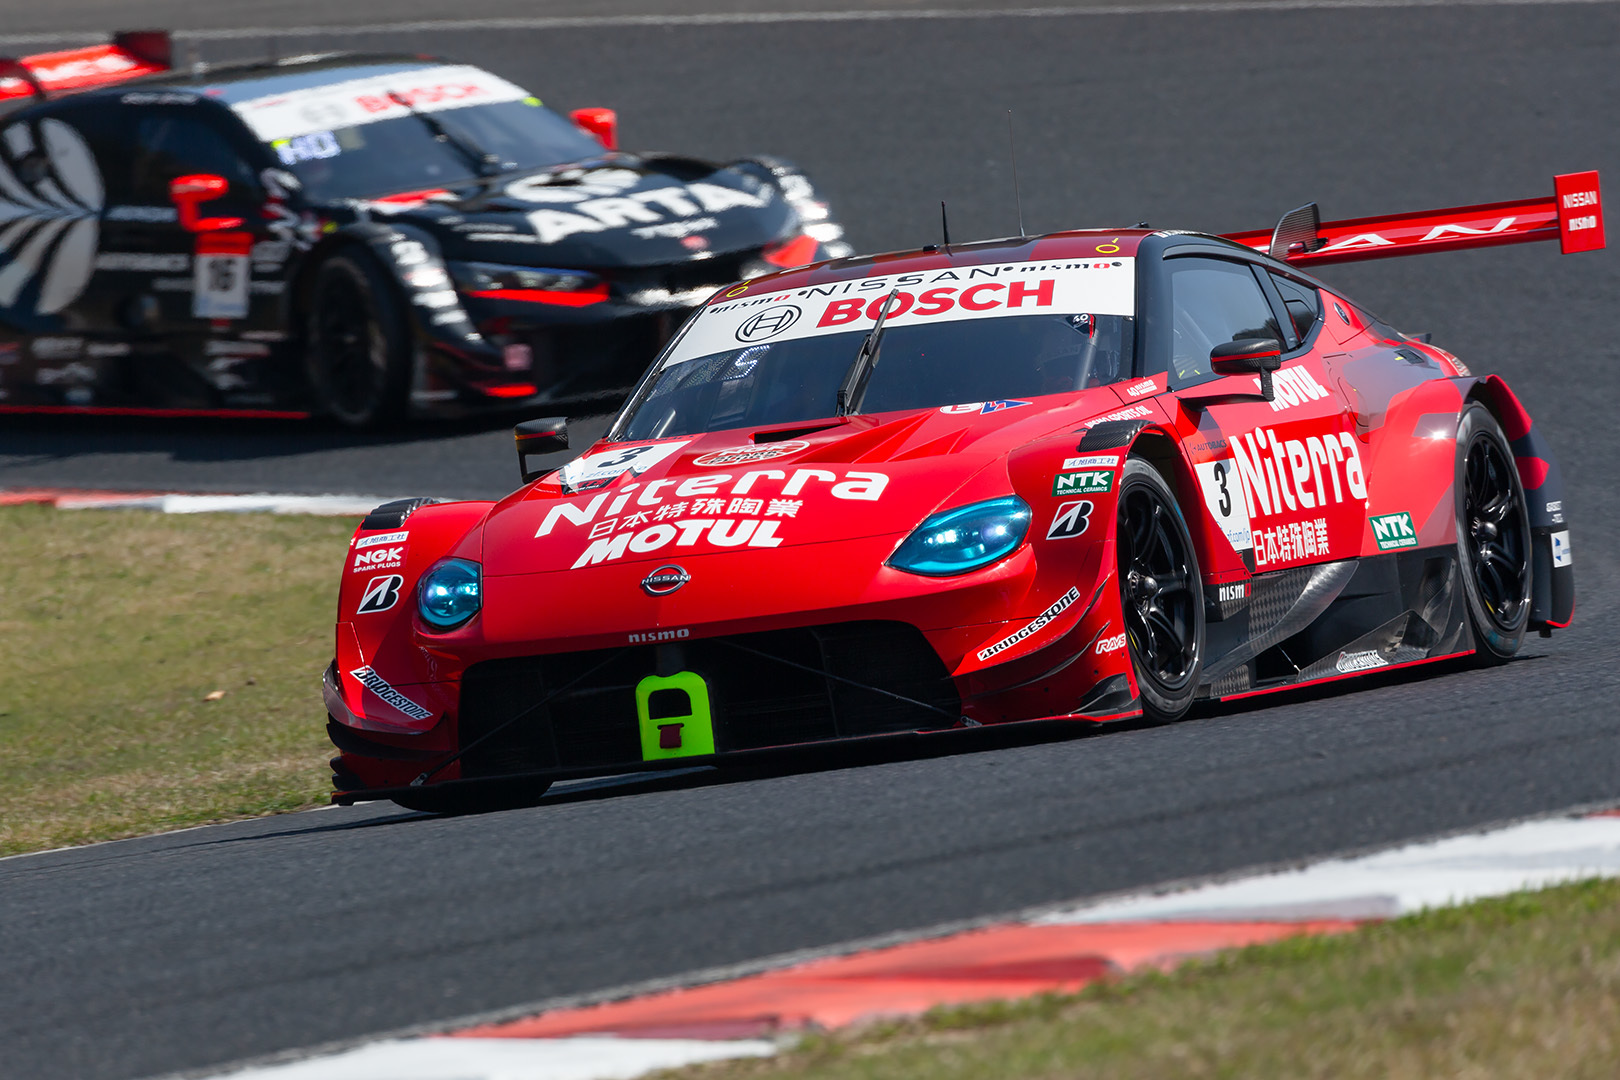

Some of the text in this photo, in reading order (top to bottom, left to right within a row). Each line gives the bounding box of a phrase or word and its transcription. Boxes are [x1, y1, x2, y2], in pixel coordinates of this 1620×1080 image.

[525, 183, 768, 244] ARTA
[1563, 191, 1598, 208] NISSAN
[716, 262, 1111, 314] nismo NISSAN nismo
[816, 279, 1055, 329] BOSCH
[1252, 365, 1330, 412] MOTUL
[1135, 405, 1153, 416] OIL
[597, 446, 654, 468] 3
[1229, 427, 1368, 519] Niterra
[1056, 471, 1110, 489] NTK
[1056, 488, 1082, 496] TECHNICAL
[1213, 462, 1232, 517] 3
[534, 468, 890, 538] Niterra
[588, 498, 803, 540] 日本特殊陶業
[1252, 517, 1331, 566] 日本特殊陶業
[1372, 513, 1414, 540] NTK
[354, 546, 404, 567] NGK
[570, 518, 785, 570] MOTUL
[353, 561, 401, 573] SPARK PLUGS
[641, 574, 690, 585] NISSAN
[1219, 584, 1251, 601] nismo
[628, 628, 690, 644] nismo
[977, 586, 1080, 661] BRIDGESTONE
[1096, 633, 1126, 655] RAYS
[350, 664, 434, 721] BRIDGESTONE
